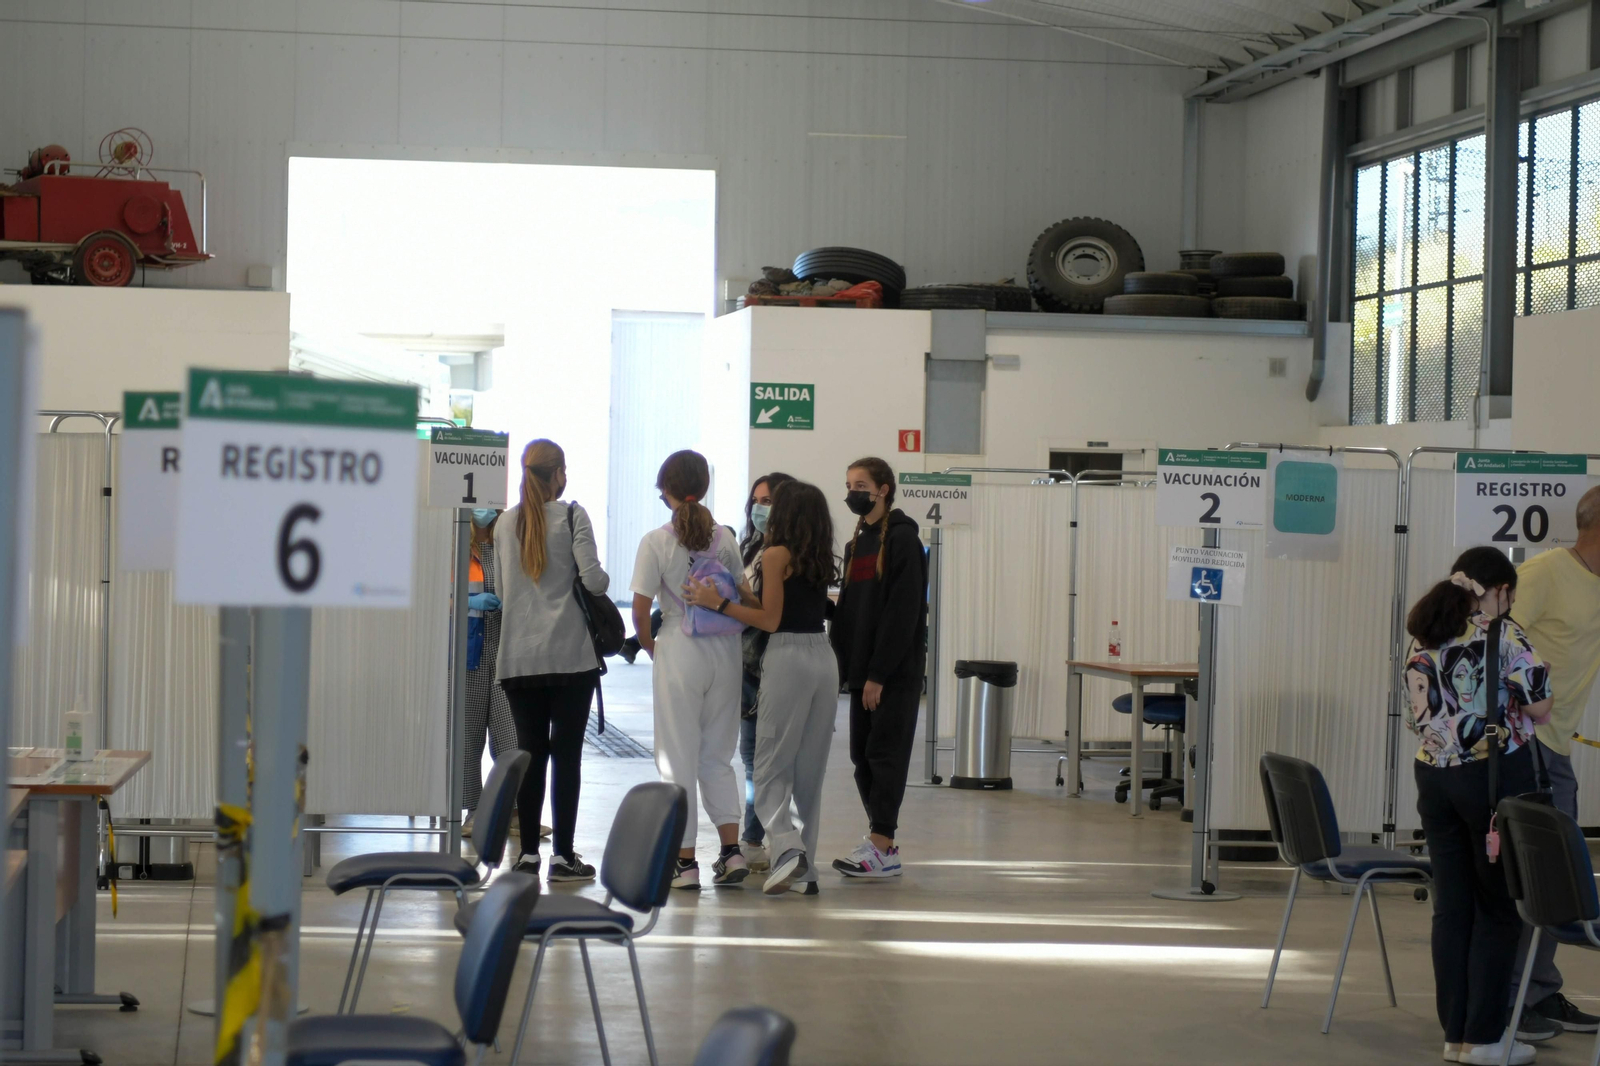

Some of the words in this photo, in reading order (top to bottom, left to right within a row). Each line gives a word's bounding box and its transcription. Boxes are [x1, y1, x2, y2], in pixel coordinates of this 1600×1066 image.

[754, 386, 811, 401] SALIDA
[220, 444, 383, 484] REGISTRO
[434, 451, 506, 467] VACUNACIÓN
[462, 472, 477, 504] 1
[1163, 472, 1260, 488] VACUNACIÓN
[902, 488, 967, 500] VACUNACIÓN
[1476, 482, 1567, 497] REGISTRO
[1285, 494, 1325, 502] MODERNA
[926, 503, 942, 525] 4
[1199, 492, 1222, 524] 2
[1492, 504, 1549, 543] 20
[277, 502, 323, 595] 6
[1175, 547, 1199, 555] PUNTO
[1172, 555, 1210, 564] MOVILIDAD
[1211, 559, 1245, 568] REDUCIDA
